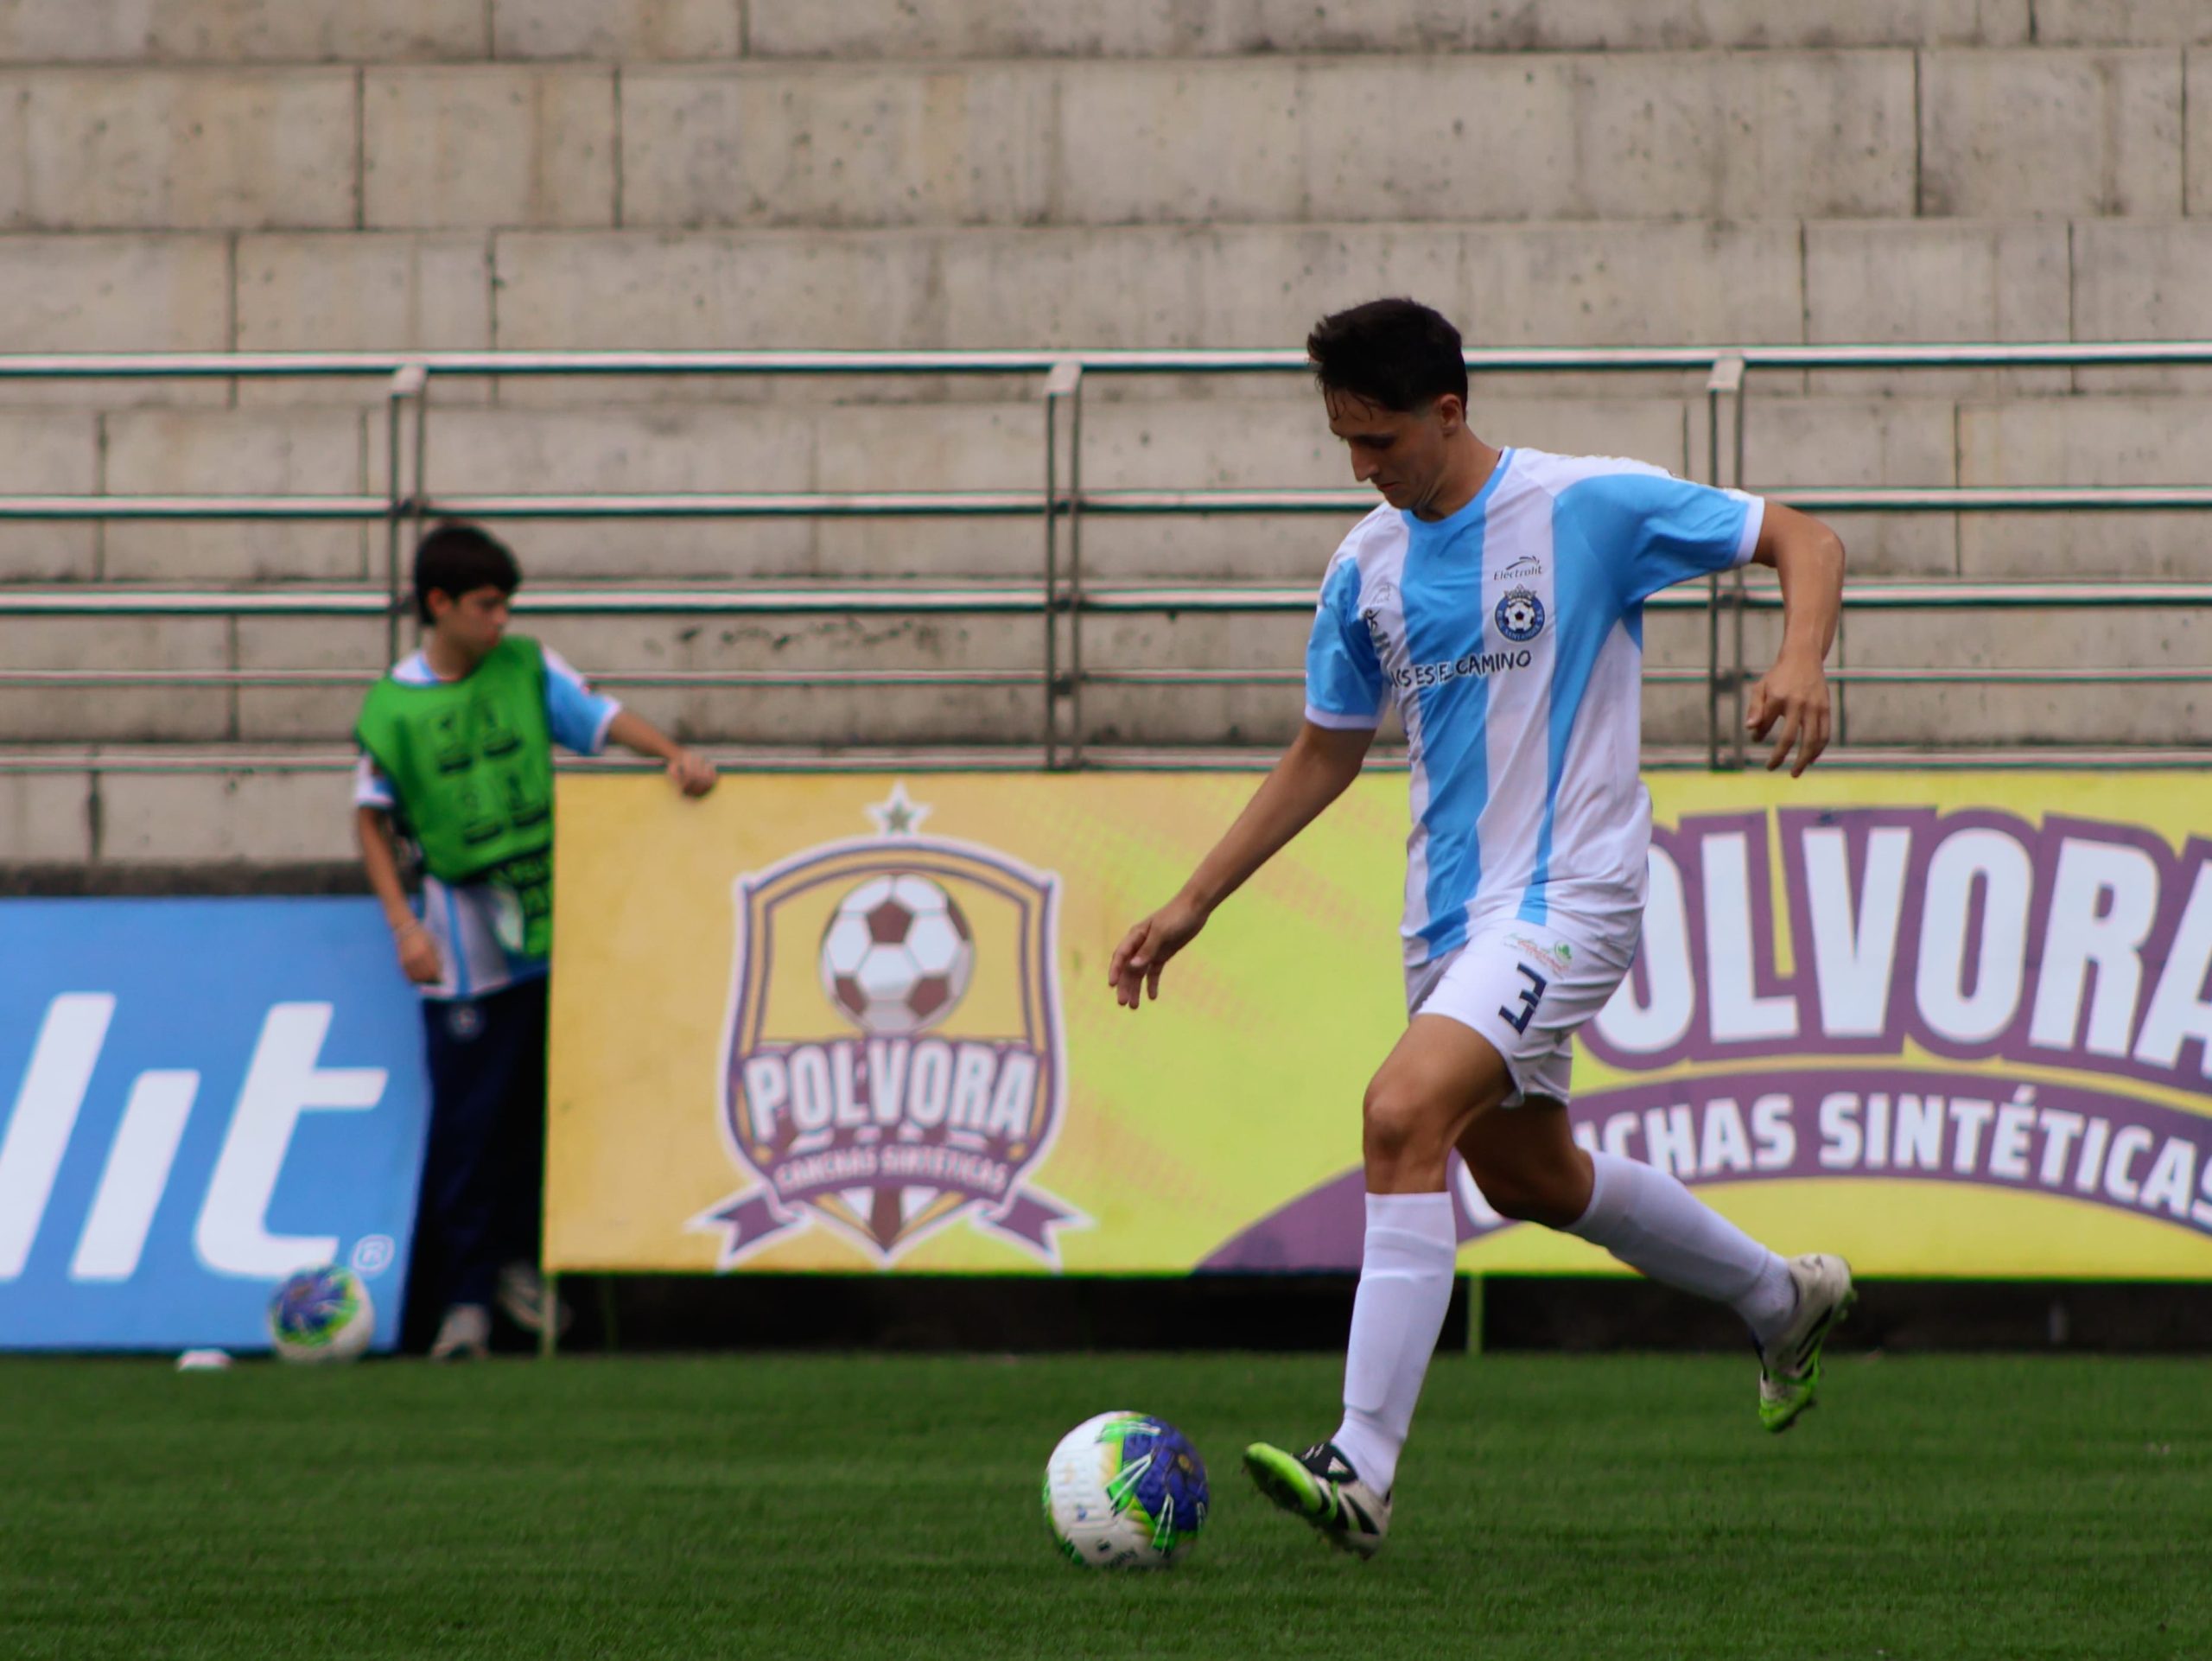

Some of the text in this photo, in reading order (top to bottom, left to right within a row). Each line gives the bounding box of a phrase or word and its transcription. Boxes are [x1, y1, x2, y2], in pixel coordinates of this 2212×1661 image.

[1455, 649, 1532, 678] CAMINO
[1497, 961, 1548, 1037] 3
[1595, 827, 2212, 1079] OLVORA
[745, 1038, 1037, 1142] POLVORA
[1458, 1092, 1796, 1228] CHAS
